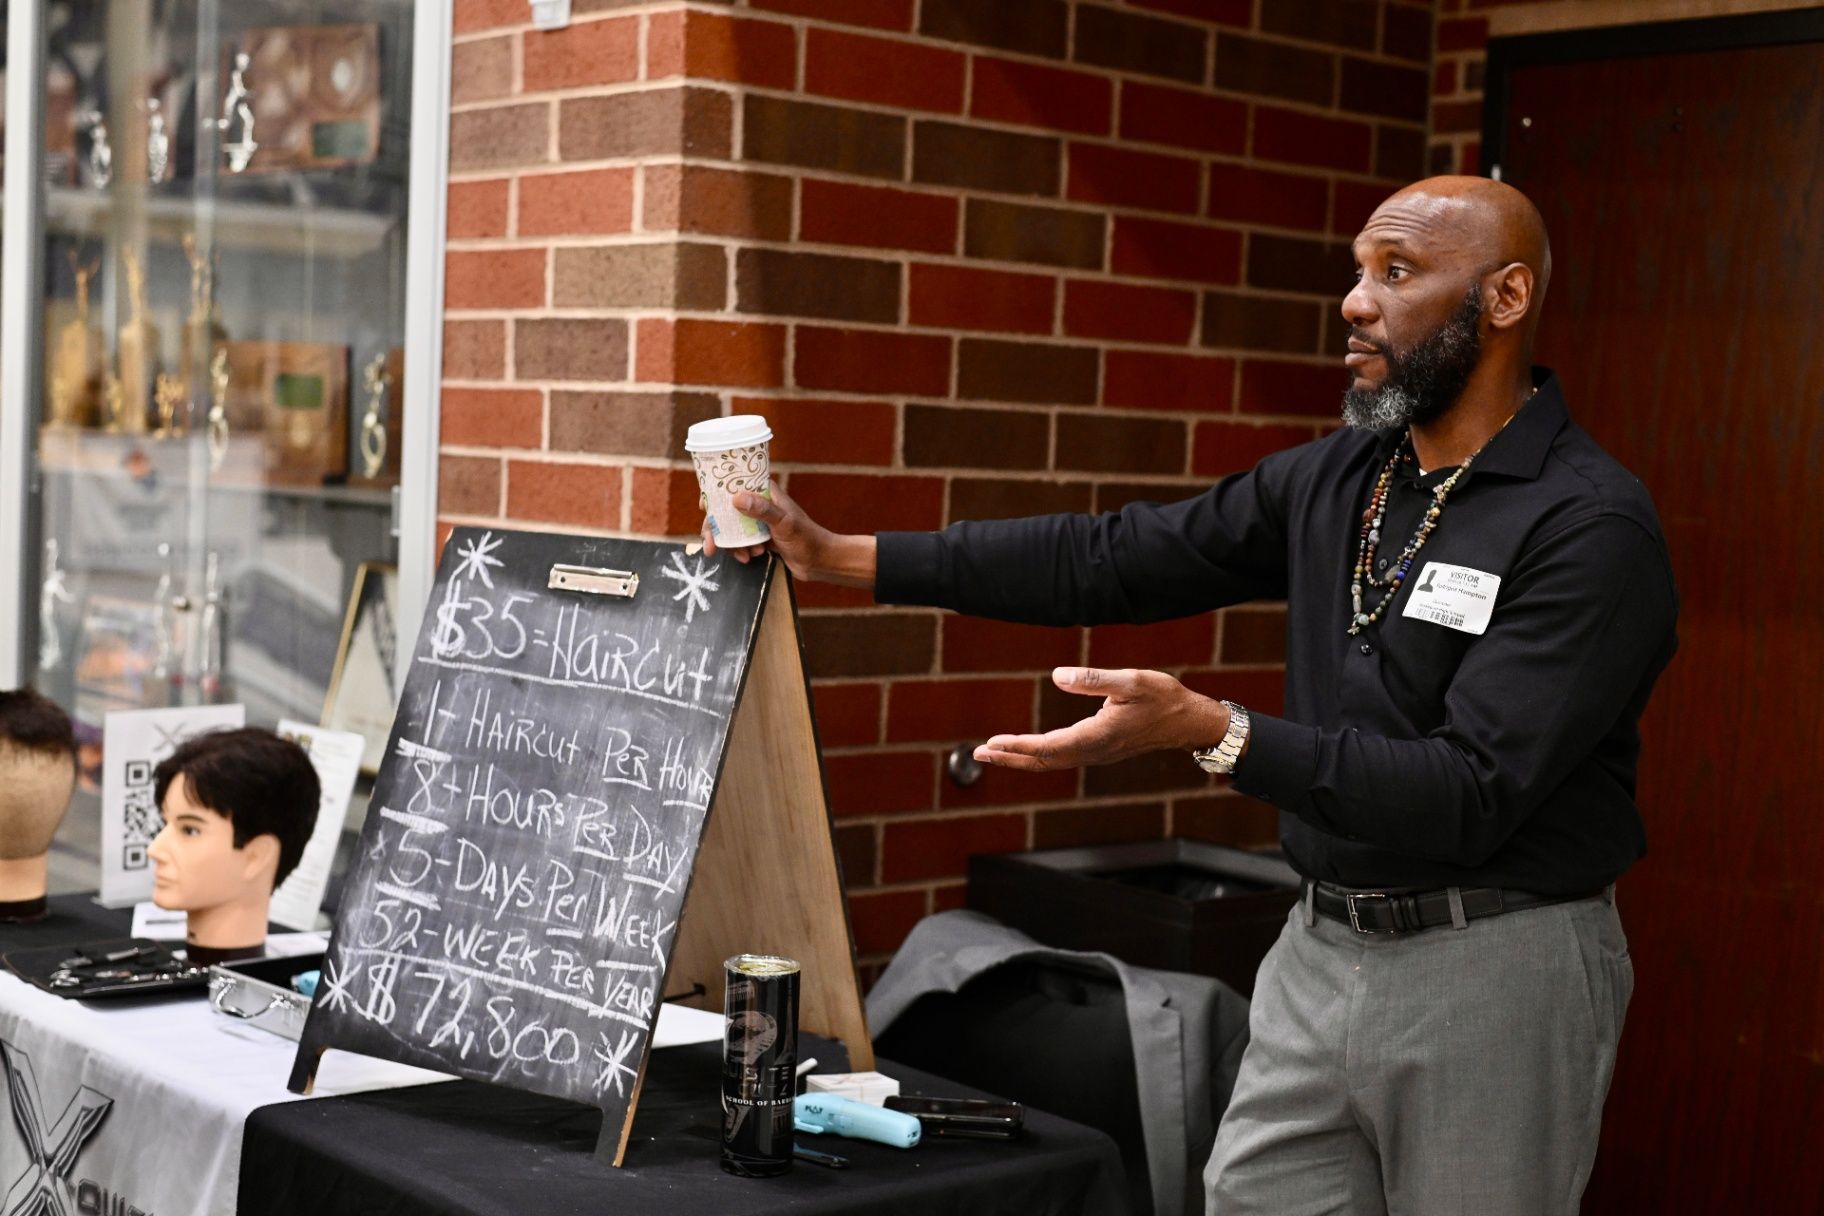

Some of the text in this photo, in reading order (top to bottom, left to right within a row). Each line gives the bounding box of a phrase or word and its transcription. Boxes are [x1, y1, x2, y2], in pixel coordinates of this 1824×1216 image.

[1450, 571, 1480, 585] VISITOR
[725, 1094, 754, 1106] SCHOOL
[756, 1099, 769, 1107] OF
